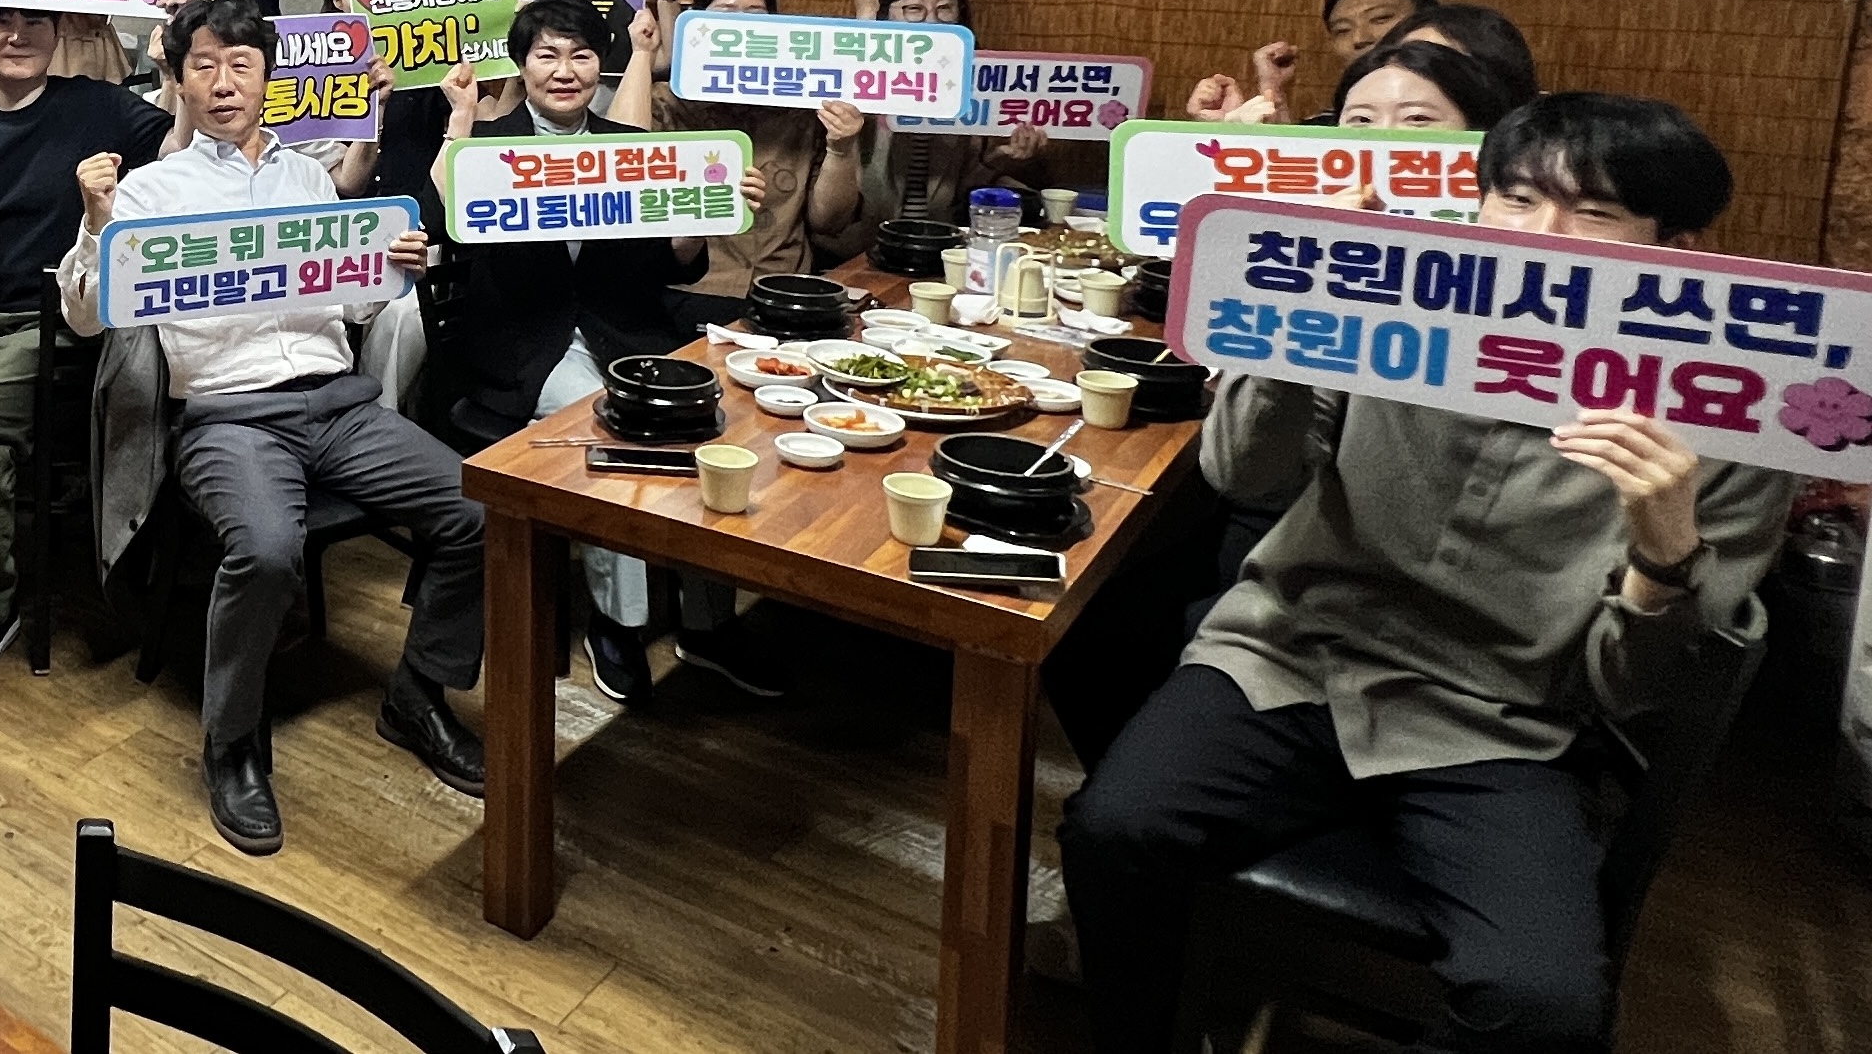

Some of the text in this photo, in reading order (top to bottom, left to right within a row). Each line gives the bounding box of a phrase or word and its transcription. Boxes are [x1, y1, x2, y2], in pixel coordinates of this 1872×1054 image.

[275, 32, 355, 68] 내세요
[709, 29, 934, 64] 오늘 뭐 먹지?
[258, 72, 370, 130] 통시장
[702, 63, 938, 103] 고민말고 외식!
[971, 64, 1120, 97] 에서 쓰면,
[998, 99, 1094, 127] 웃어요
[510, 146, 687, 190] 오늘의 점심,
[1213, 148, 1373, 195] 오늘의
[465, 184, 737, 235] 우리 동네에 활력을
[1139, 201, 1182, 246] 우
[140, 211, 381, 274] 오늘 뭐 먹지?
[134, 253, 384, 320] 고민말고 외식!
[1243, 230, 1851, 370] 창원에서 쓰면,
[1204, 297, 1767, 435] 창원이 웃어요
